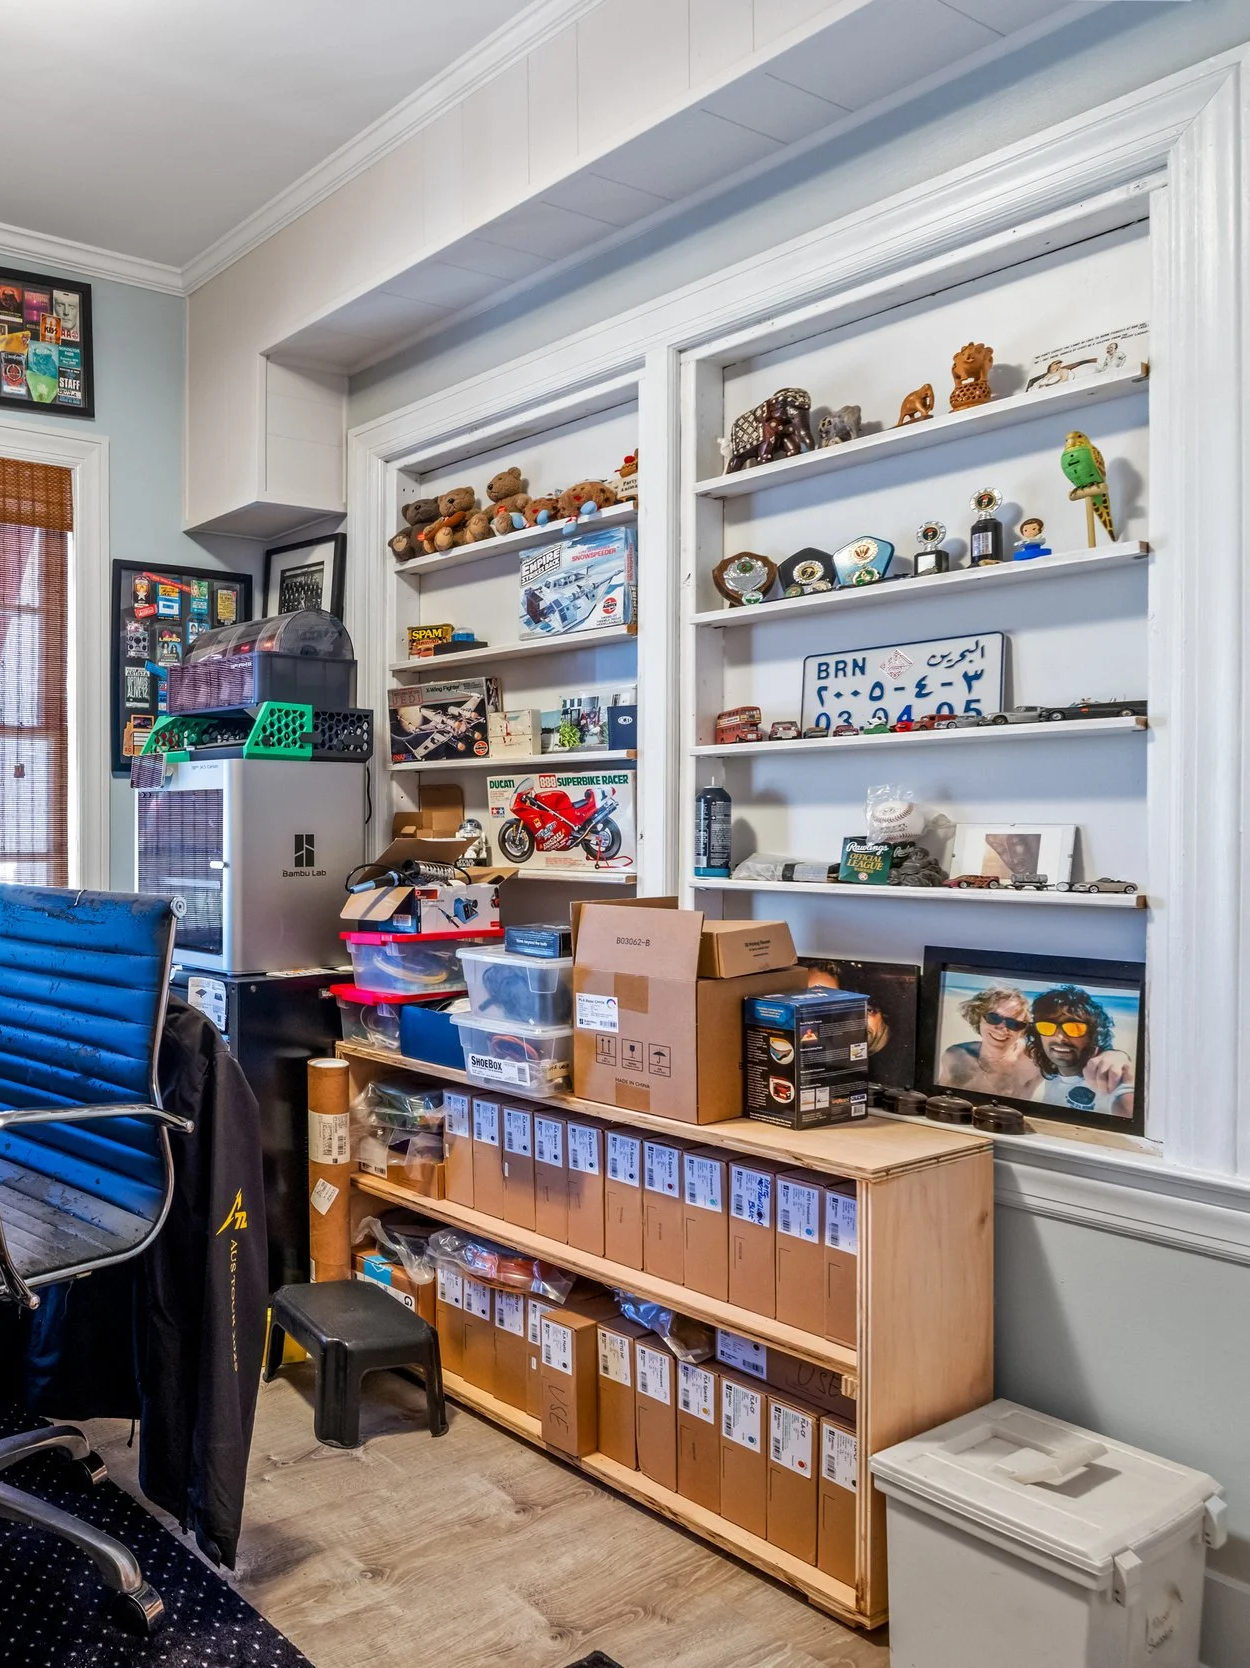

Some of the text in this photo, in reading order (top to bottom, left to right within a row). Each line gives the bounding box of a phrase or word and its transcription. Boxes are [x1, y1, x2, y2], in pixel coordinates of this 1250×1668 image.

[44, 326, 58, 335] KISS
[59, 377, 80, 390] STAFF
[572, 548, 617, 561] SNOWSPEEDER
[522, 549, 561, 575] EMPIRE
[412, 628, 442, 640] SPAM
[817, 657, 866, 680] BRN
[394, 694, 422, 707] JEDI
[490, 775, 629, 789] DUCATI 888 SUPERBIKE RACER
[846, 842, 889, 855] Rawlings
[850, 853, 882, 863] OFFICIAL
[847, 859, 883, 871] LEAGUE
[283, 869, 327, 877] Bambu Lab
[616, 937, 650, 947] B03062-B
[615, 1077, 628, 1085] MADE
[635, 1081, 650, 1089] CHINA
[229, 1239, 238, 1272] AUS
[796, 1362, 841, 1398] USE
